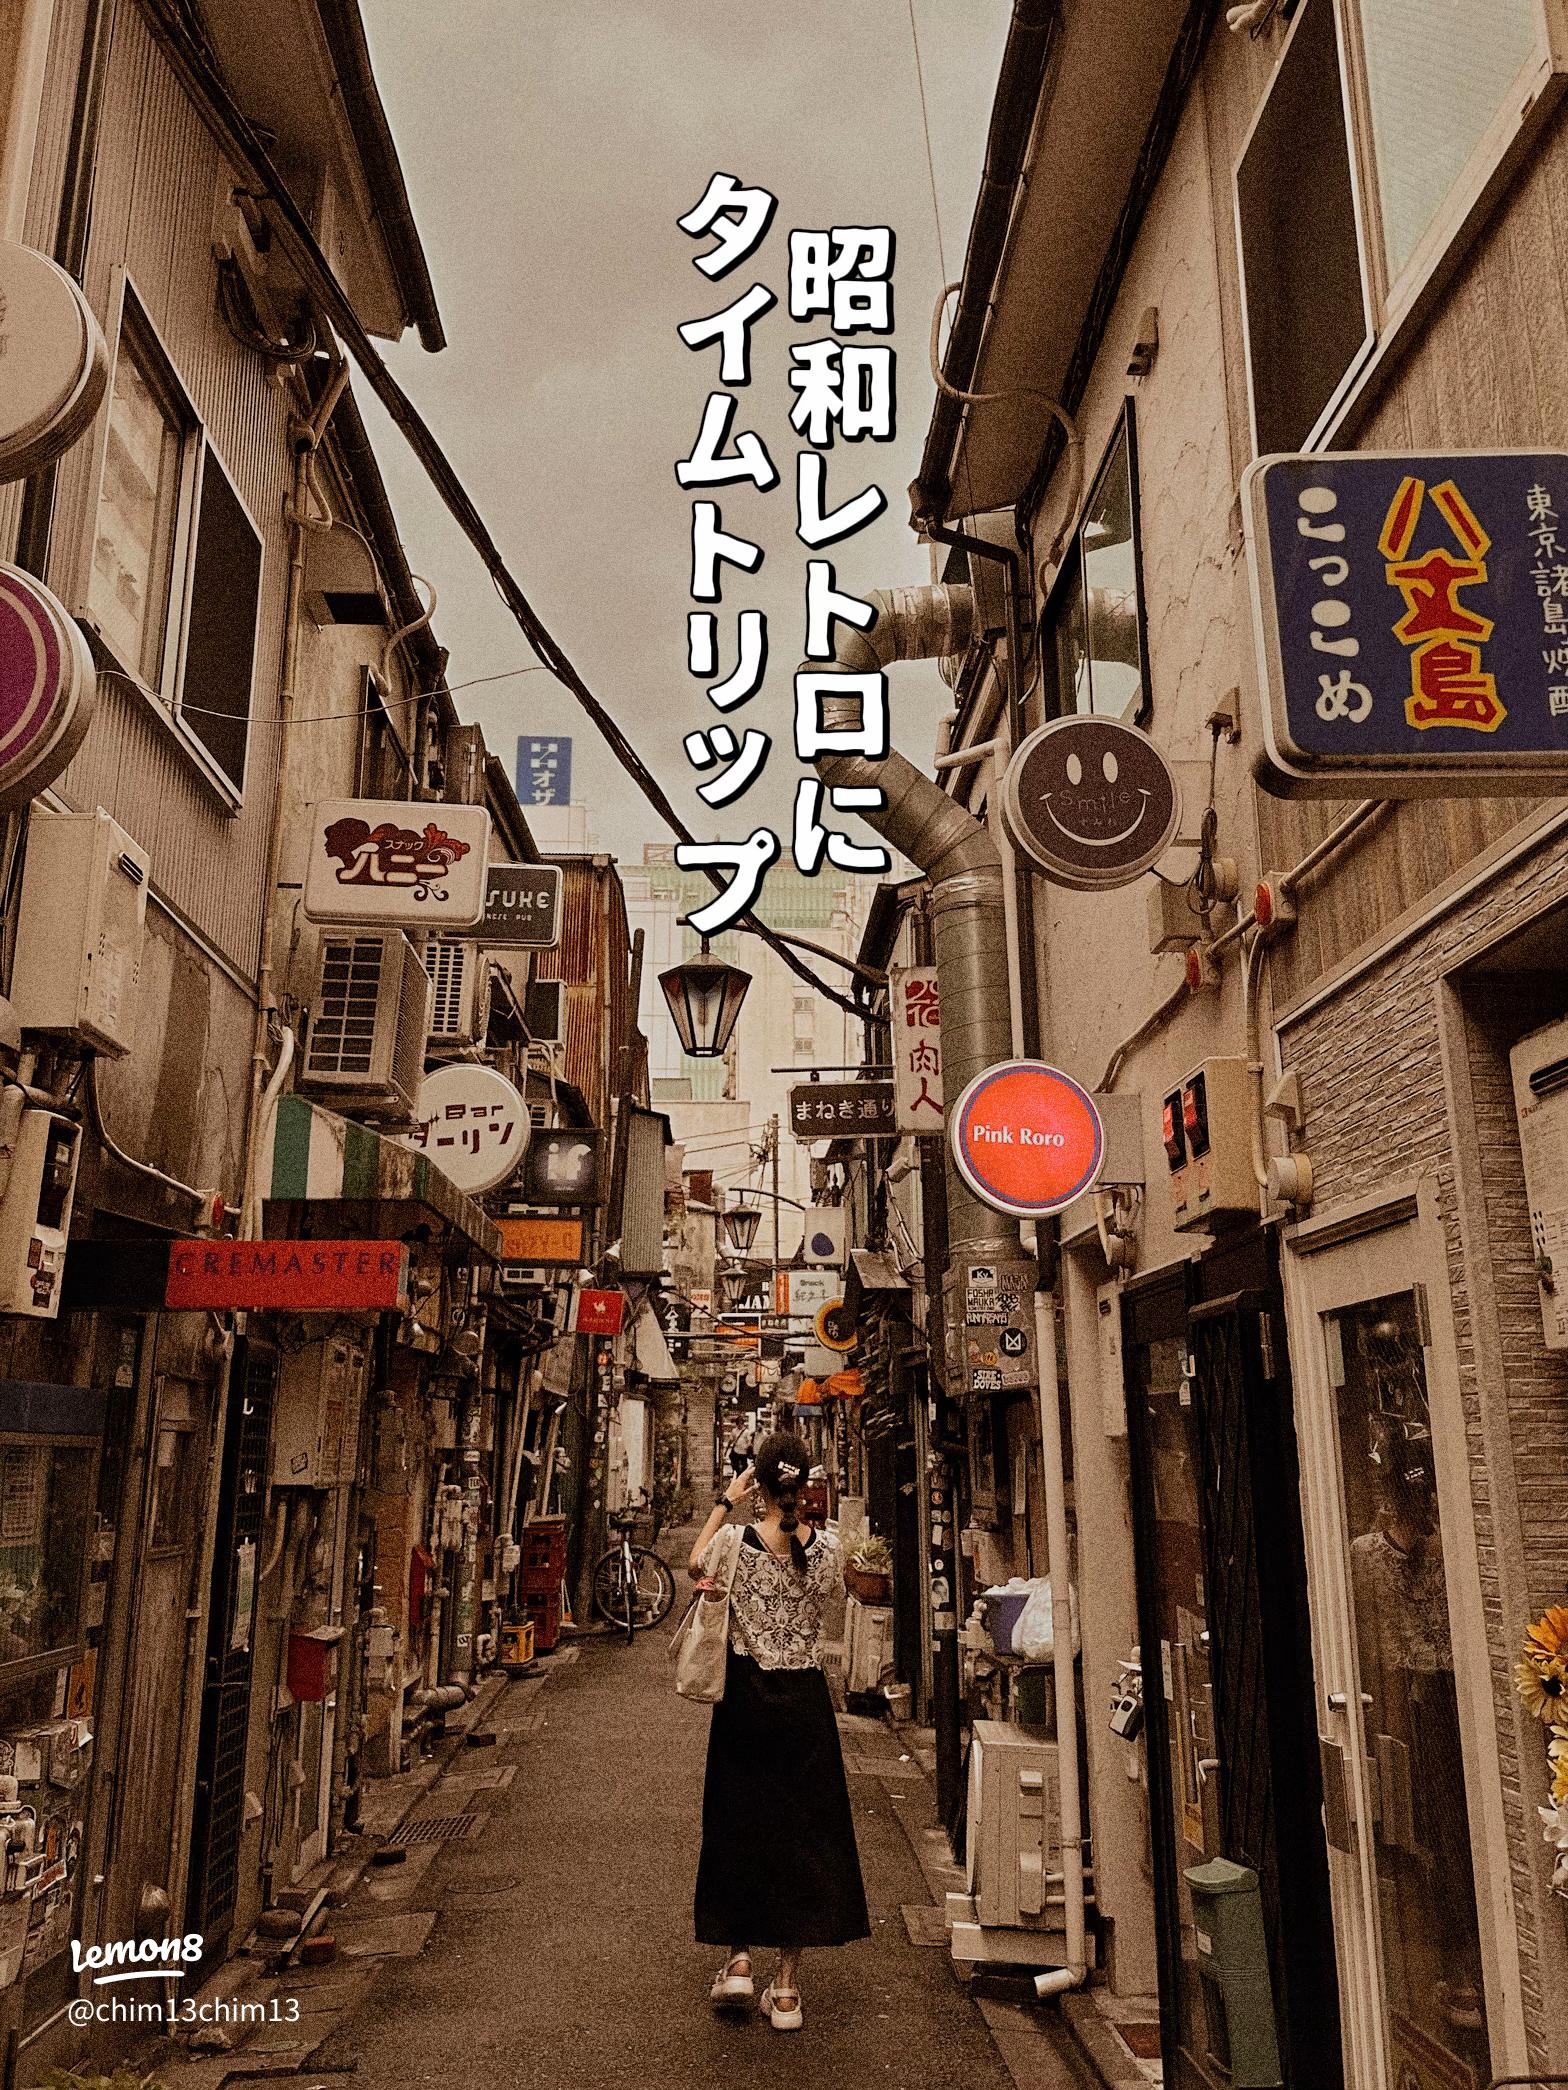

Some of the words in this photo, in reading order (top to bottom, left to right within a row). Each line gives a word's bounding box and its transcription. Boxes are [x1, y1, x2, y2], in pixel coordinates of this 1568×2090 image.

[1297, 487, 1373, 723] こっこめ
[1377, 477, 1507, 732] 八丈島
[1060, 790, 1130, 812] Smile
[385, 839, 424, 850] スナック
[338, 842, 447, 884] ハニー
[910, 1039, 943, 1114] 肉人
[446, 1104, 503, 1120] Bar
[796, 1100, 894, 1121] まねき通り
[973, 1124, 1013, 1145] Pink
[1020, 1129, 1065, 1147] Roro
[548, 1142, 592, 1180] if
[175, 1251, 397, 1276] CREMASTER
[974, 1379, 1001, 1390] DOVES
